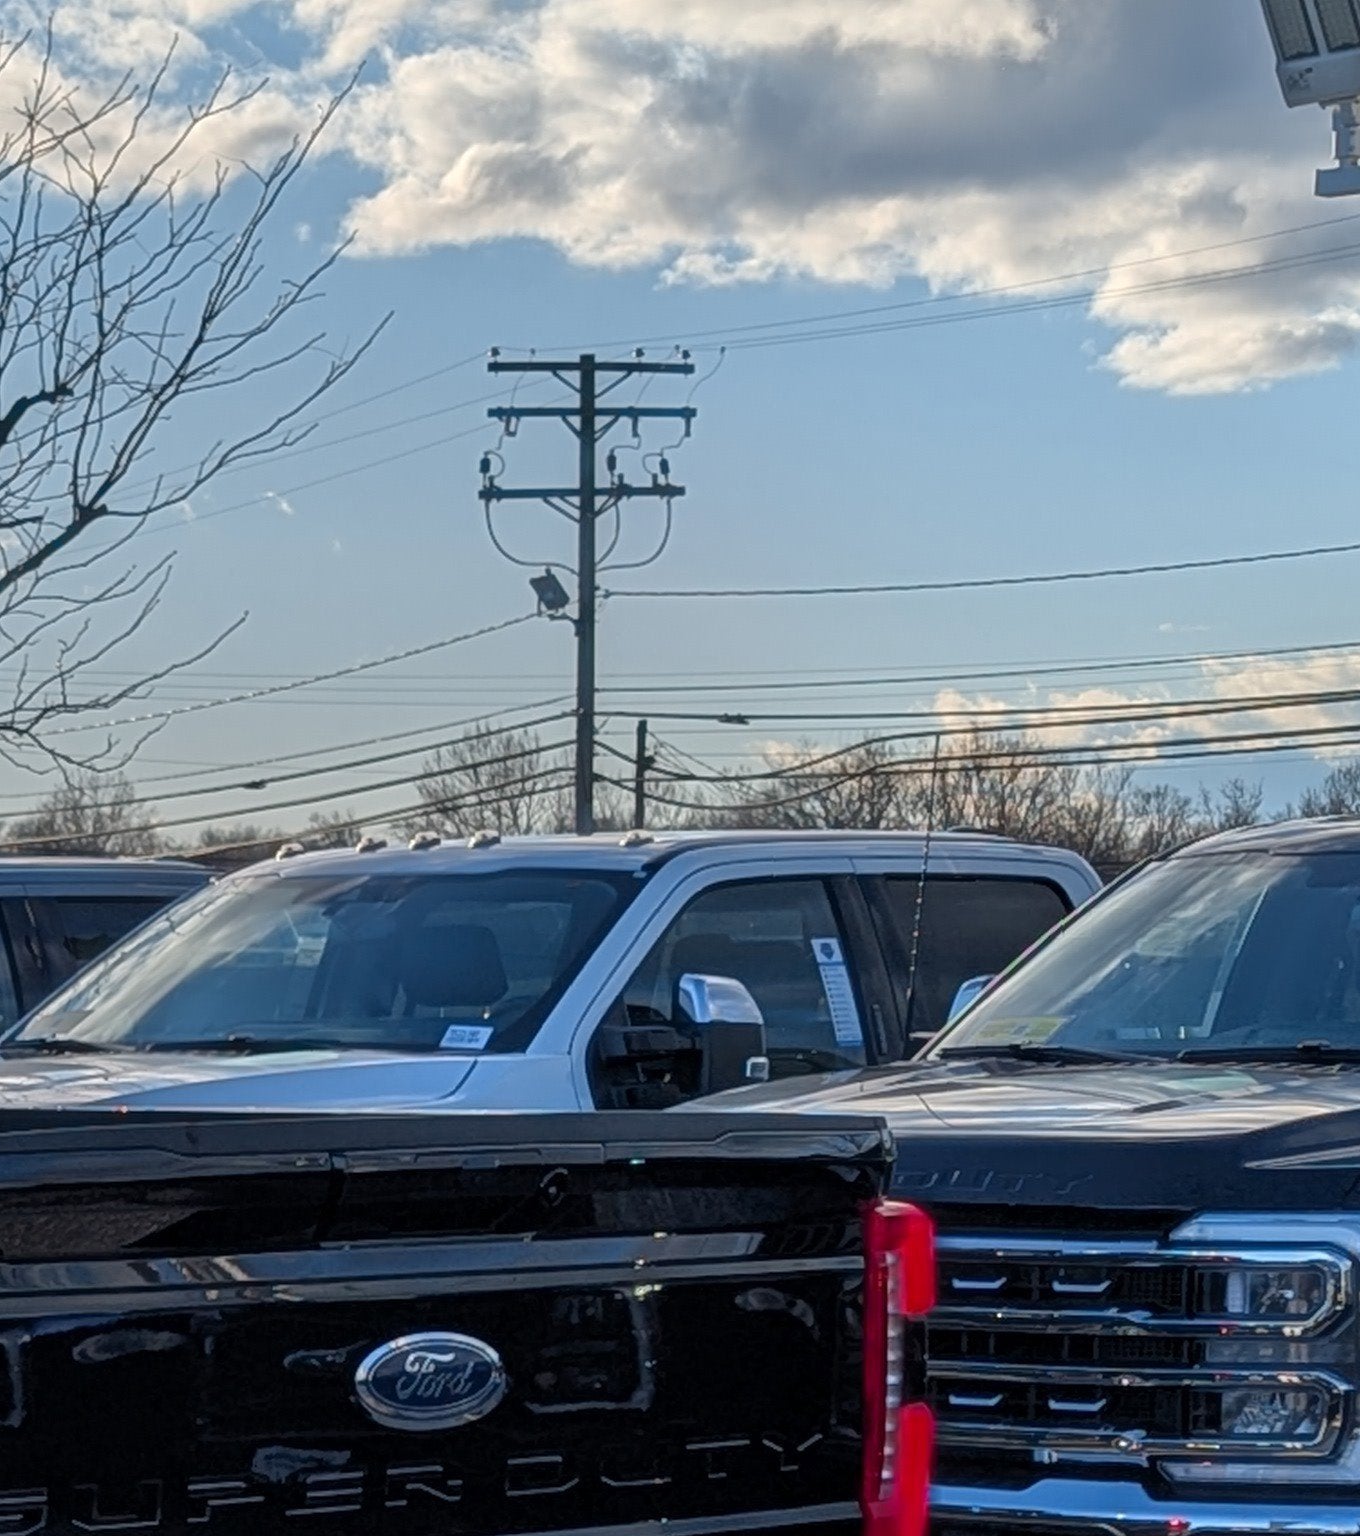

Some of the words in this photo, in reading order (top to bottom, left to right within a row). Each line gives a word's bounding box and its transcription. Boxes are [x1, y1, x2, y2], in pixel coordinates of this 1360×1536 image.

[890, 1168, 1095, 1195] DUTY
[395, 1350, 475, 1400] Ford
[505, 1433, 823, 1497] DUTY
